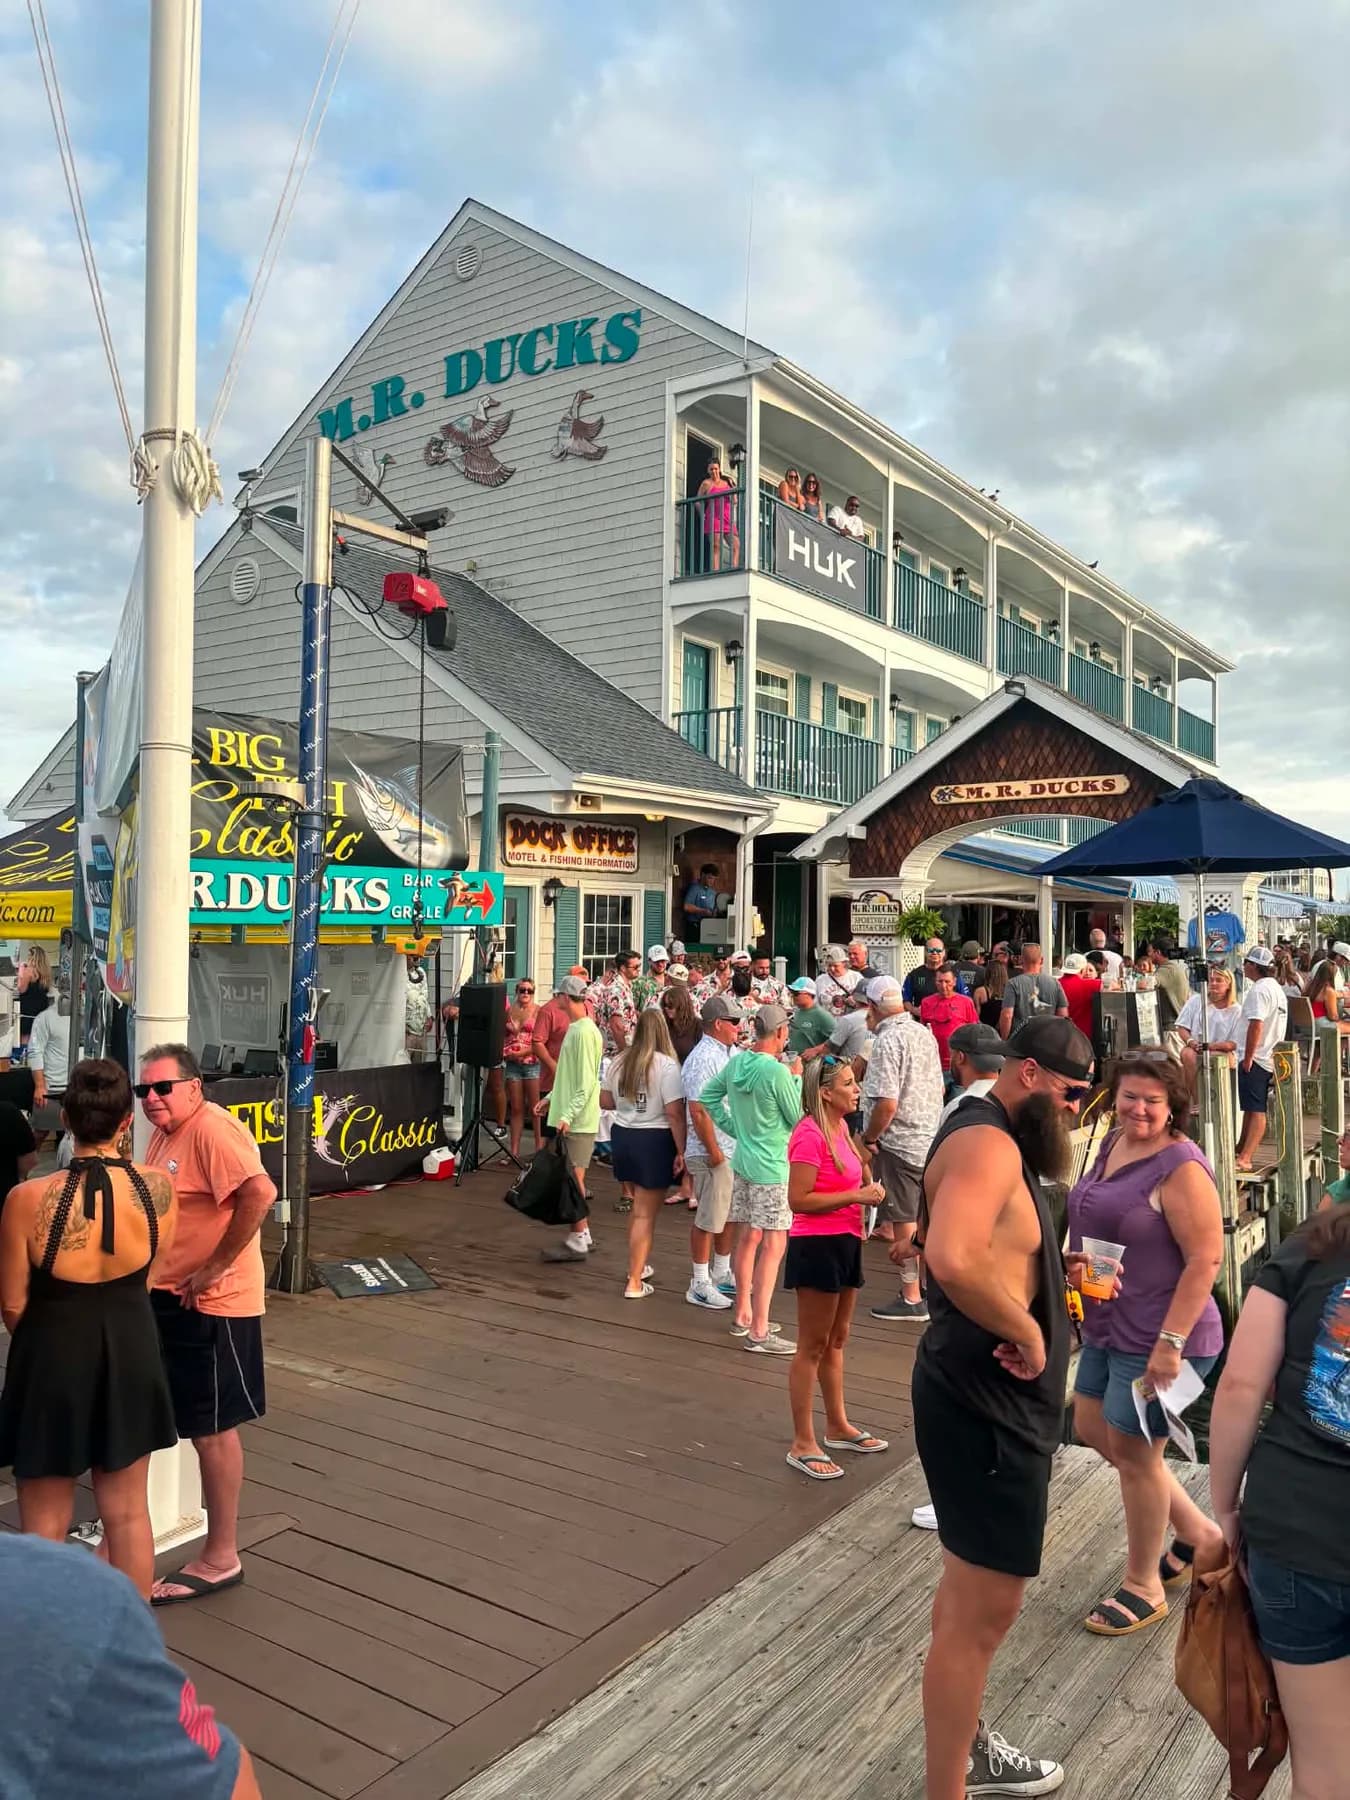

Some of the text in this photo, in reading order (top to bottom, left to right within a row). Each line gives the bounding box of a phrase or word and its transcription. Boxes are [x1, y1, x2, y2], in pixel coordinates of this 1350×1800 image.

[444, 309, 642, 398] DUCKS
[788, 528, 857, 590] HUK
[206, 727, 287, 772] BIG
[1030, 778, 1116, 796] DUCKS
[509, 817, 636, 854] DOCK OFFICE
[508, 851, 636, 869] MOTEL & FISHING INFORMATION
[403, 873, 434, 887] BAR
[391, 904, 442, 919] GRLE
[340, 1105, 438, 1161] Classic
